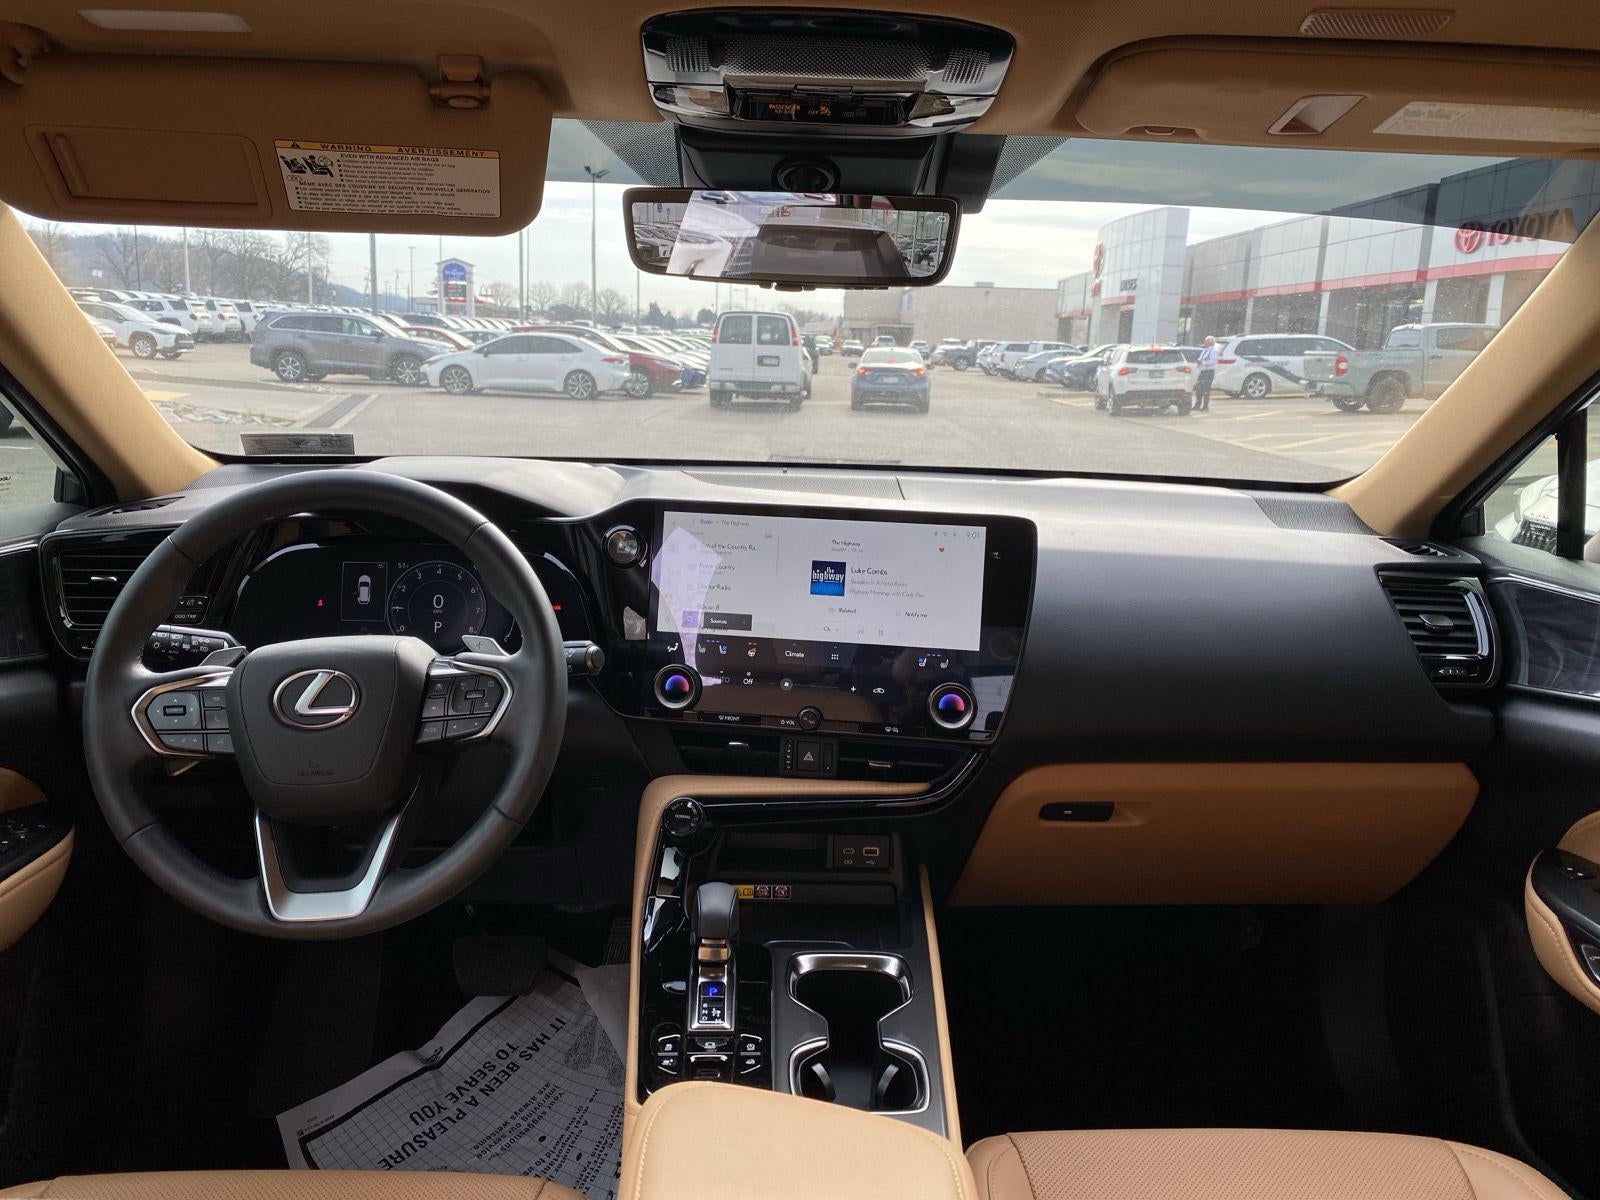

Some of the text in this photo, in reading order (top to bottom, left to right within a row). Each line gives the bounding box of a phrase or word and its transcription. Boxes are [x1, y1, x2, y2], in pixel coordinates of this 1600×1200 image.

[320, 144, 372, 152] WARNING
[398, 146, 485, 157] AVERTISSEMENT
[812, 568, 844, 583] highway
[867, 567, 888, 575] Combs
[433, 594, 444, 608] 0
[434, 621, 442, 633] P
[709, 986, 718, 996] P
[548, 1015, 566, 1034] IT
[518, 1032, 549, 1063] HAS
[408, 1042, 518, 1126] TO SERVE YOU
[478, 1060, 519, 1098] BEEN
[464, 1095, 478, 1105] A
[521, 1085, 559, 1122] improving
[470, 1082, 551, 1151] are always welcome.
[499, 1091, 564, 1152] Your suggestions
[508, 1123, 522, 1134] our
[564, 1116, 576, 1132] the
[602, 1105, 618, 1134] WITH
[377, 1107, 466, 1172] PLEASURE
[541, 1088, 600, 1174] the most important
[476, 1132, 507, 1159] service
[544, 1133, 565, 1159] world
[552, 1128, 584, 1174] customer
[590, 1135, 605, 1158] THIS
[534, 1158, 546, 1167] to
[577, 1132, 612, 1191] CARPETING
[589, 1152, 609, 1182] TRIED
